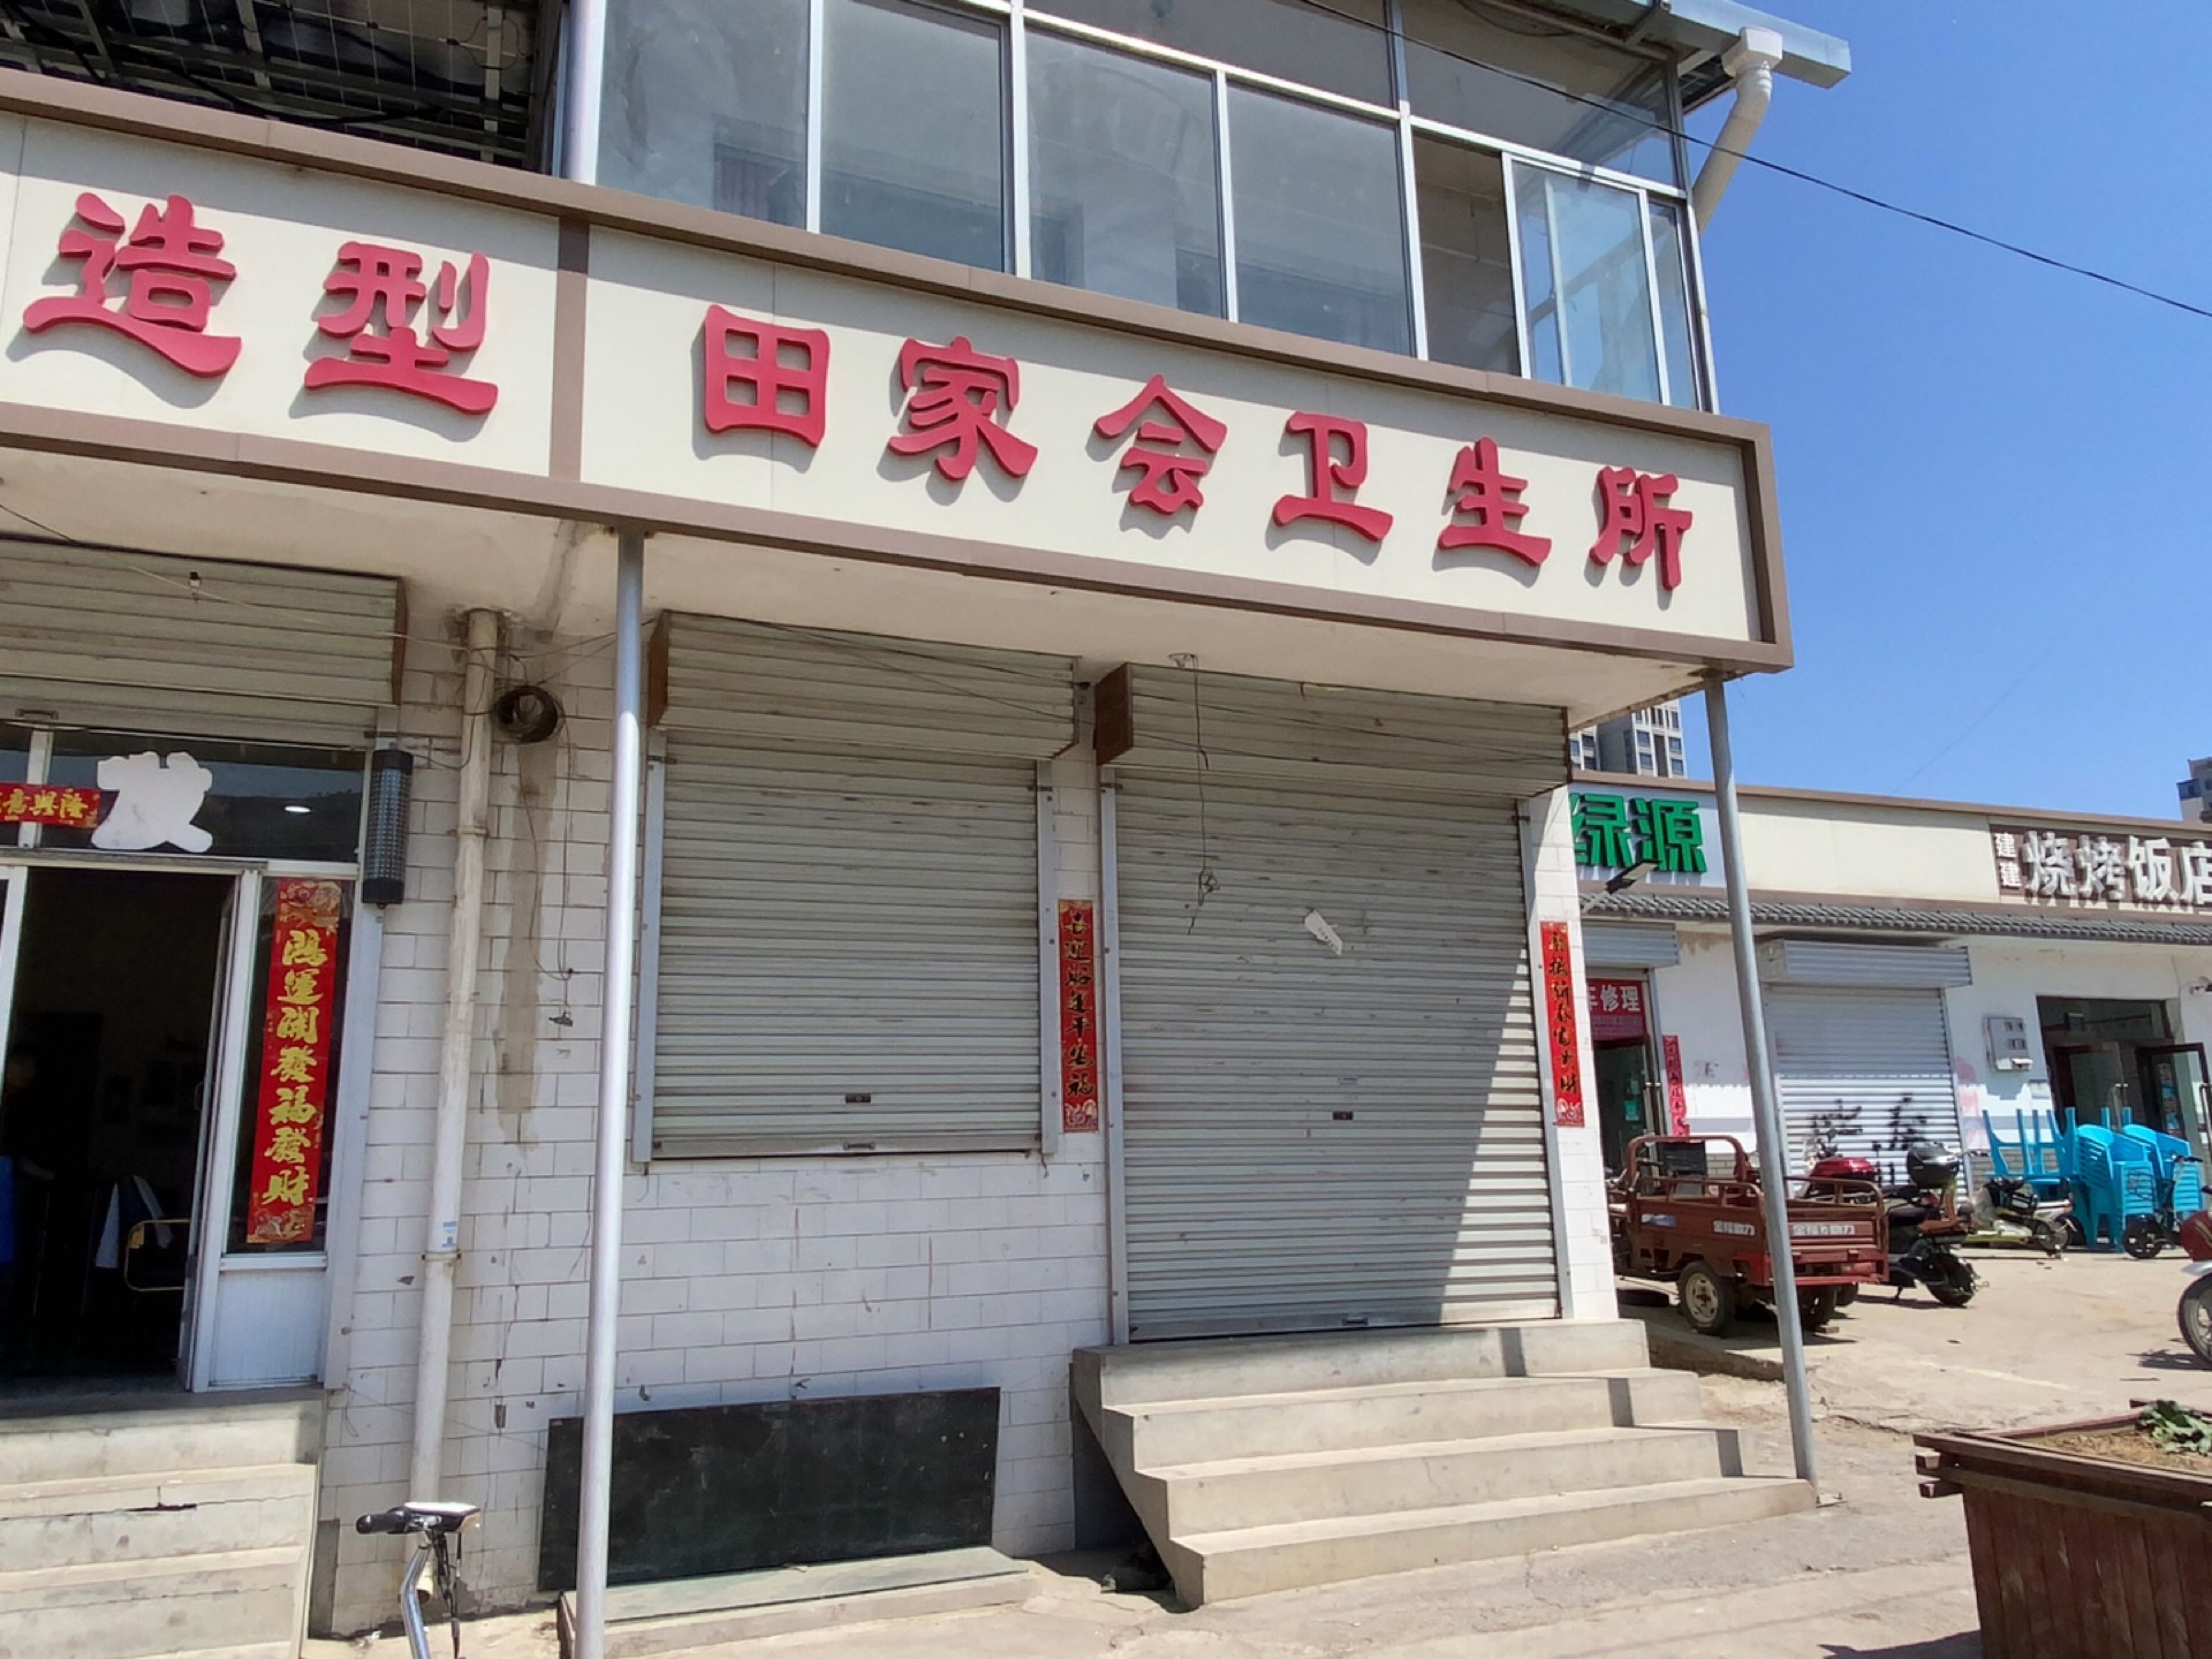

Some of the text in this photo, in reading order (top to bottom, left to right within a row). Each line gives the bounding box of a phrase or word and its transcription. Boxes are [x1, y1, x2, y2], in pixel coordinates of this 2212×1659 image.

[22, 192, 499, 415] 造型
[703, 303, 1693, 591] 田家会卫生所
[1570, 792, 1707, 873] 绿源
[2021, 831, 2212, 906] 烧烤饭店
